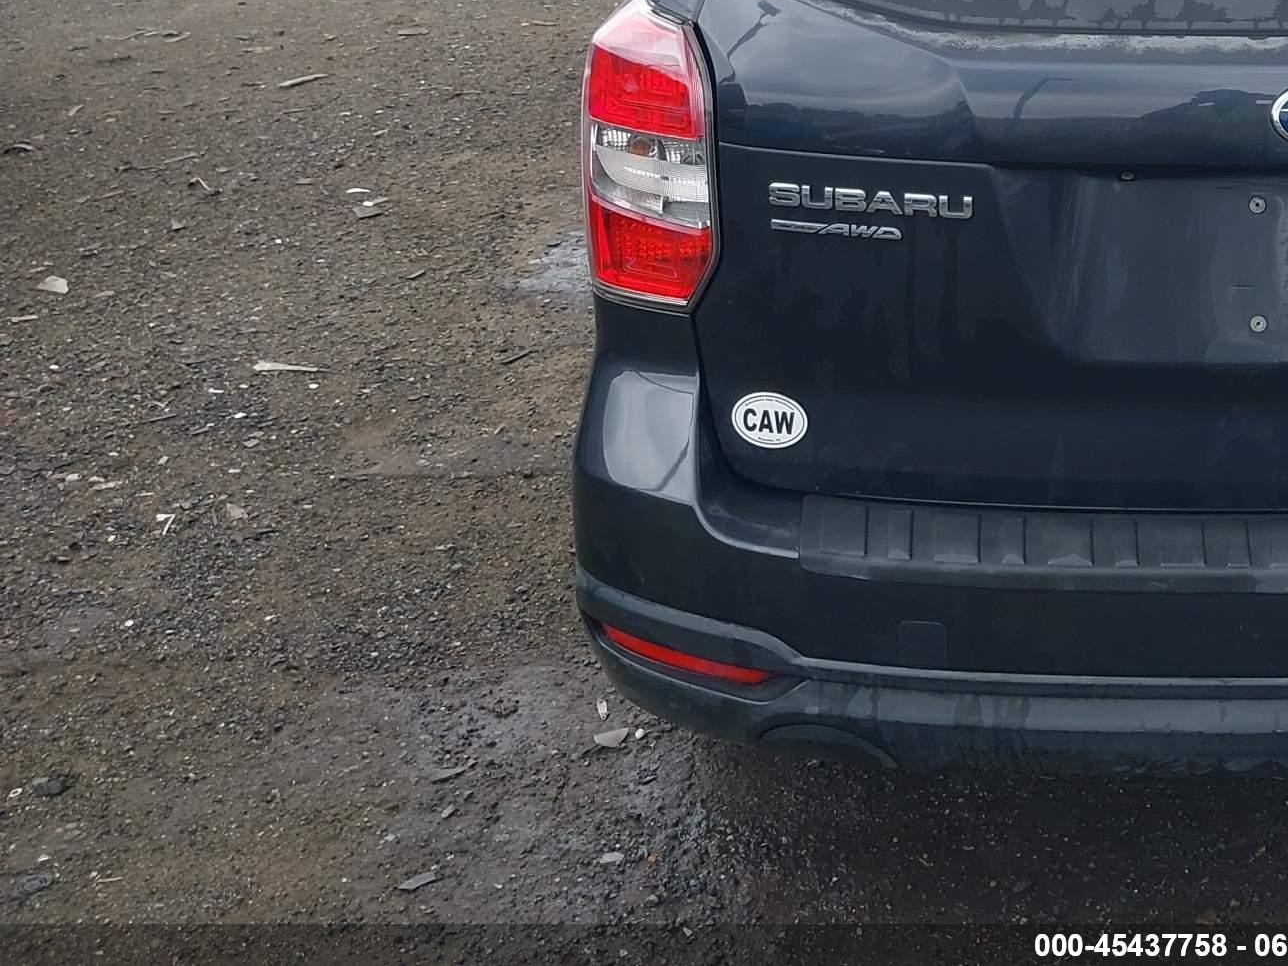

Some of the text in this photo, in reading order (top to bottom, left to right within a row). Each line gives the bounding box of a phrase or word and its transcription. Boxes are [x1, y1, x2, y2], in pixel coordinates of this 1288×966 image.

[768, 182, 973, 220] SUBARU
[818, 223, 903, 240] AWD
[743, 407, 796, 435] CAW
